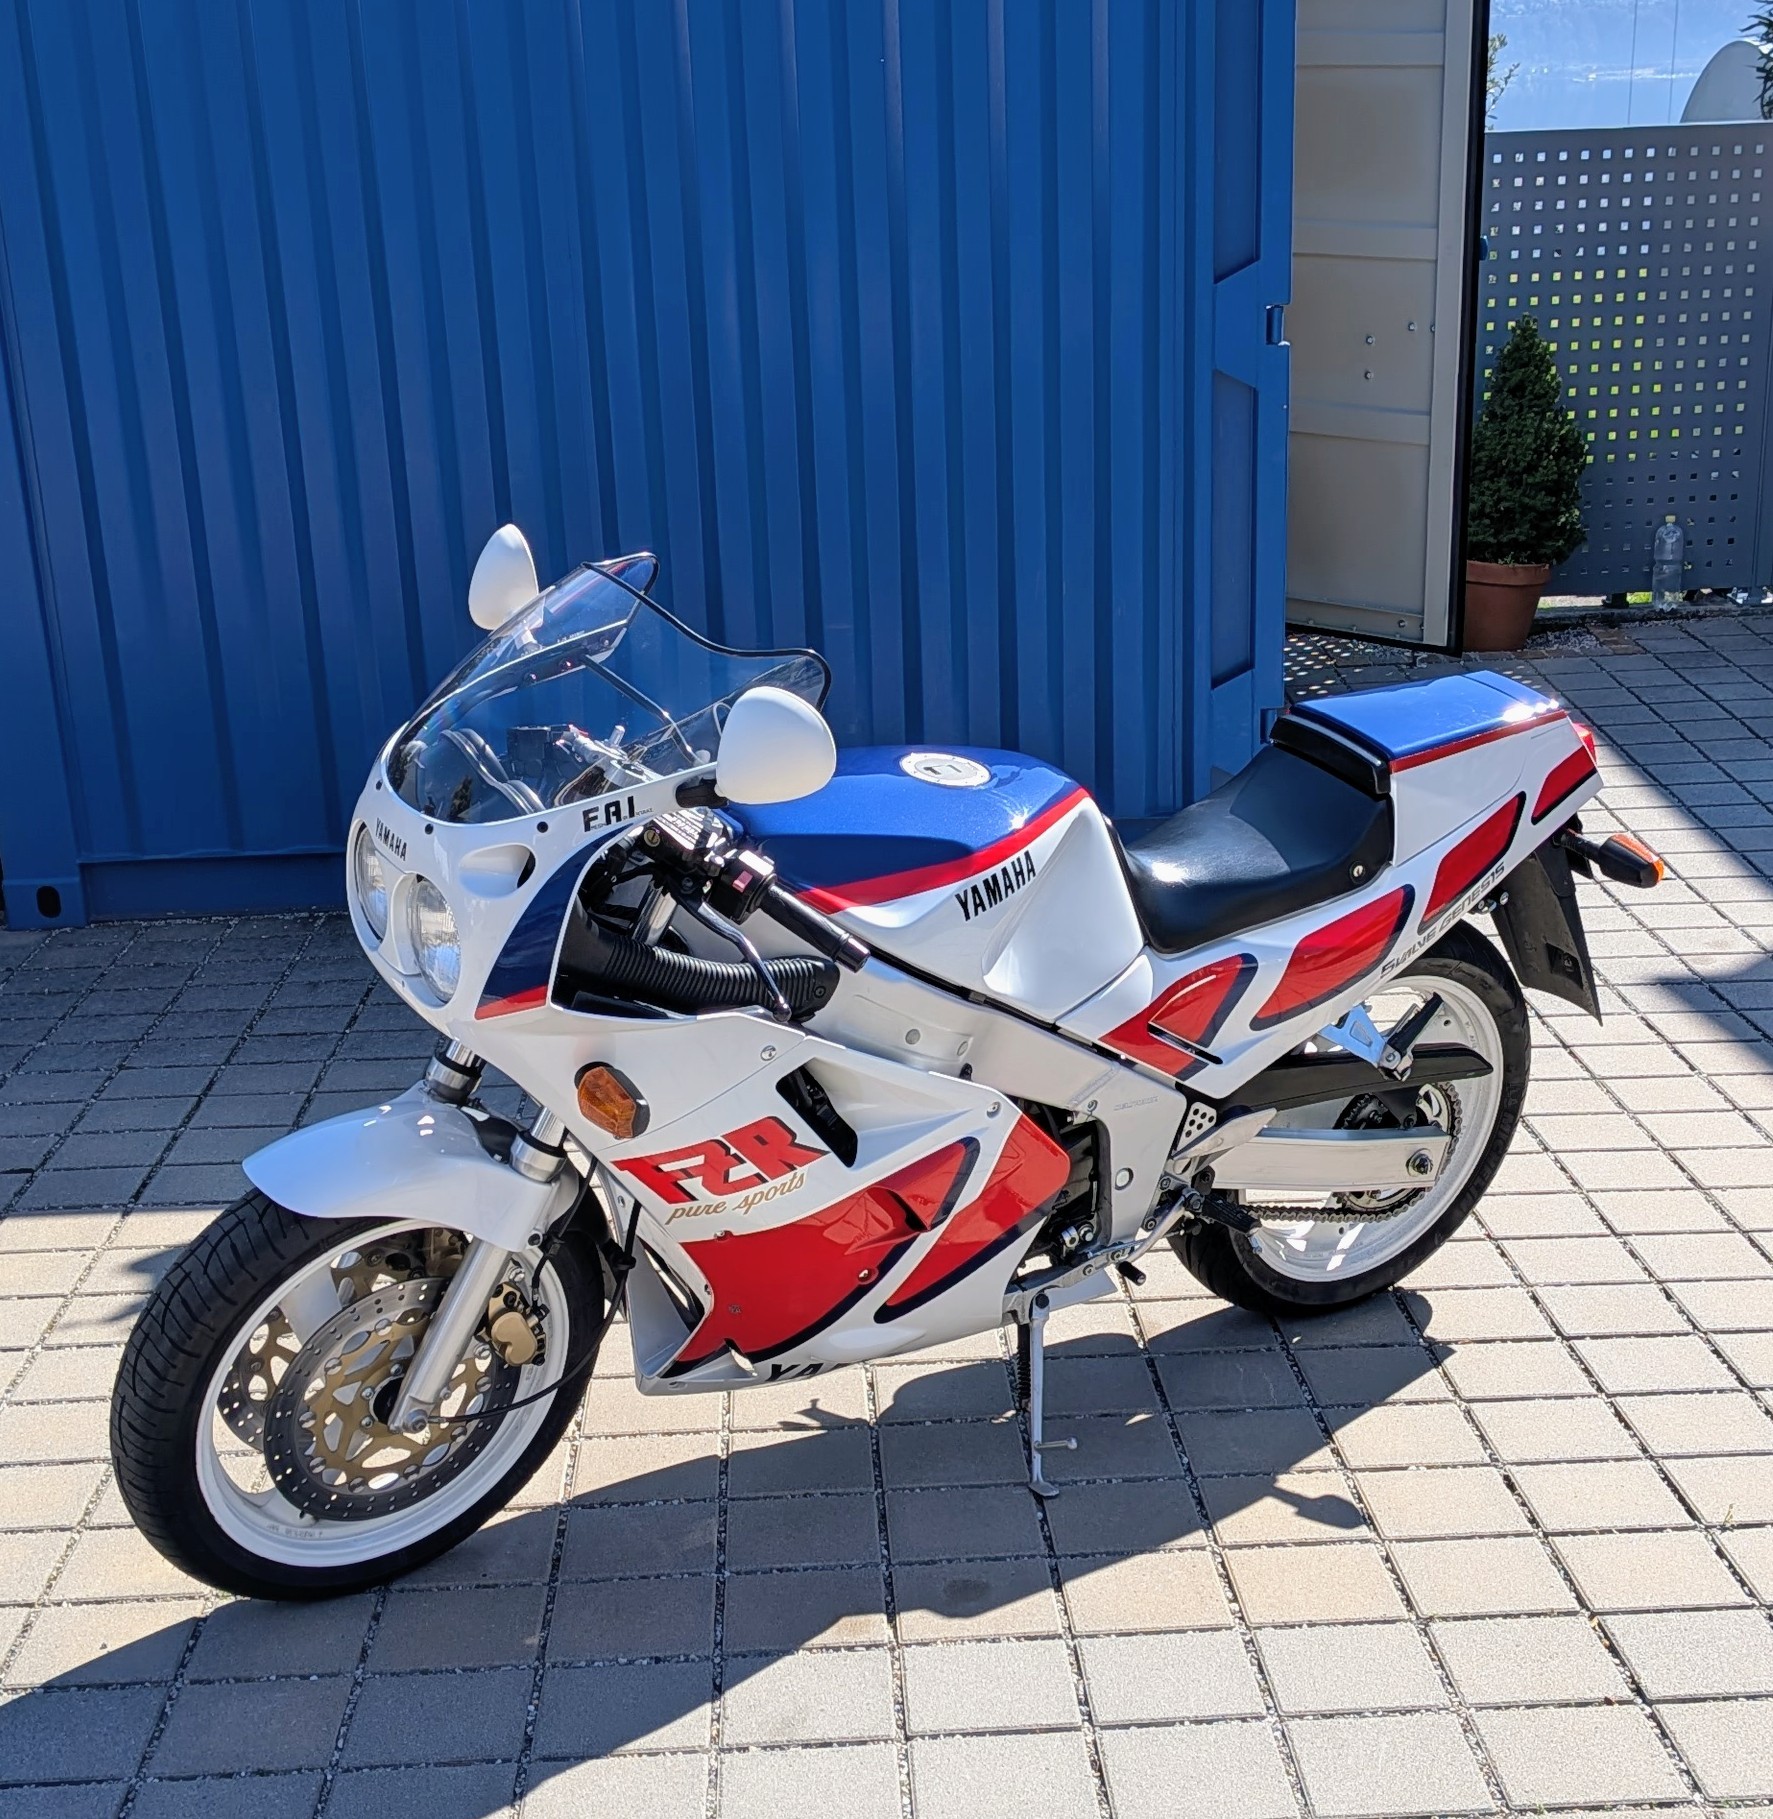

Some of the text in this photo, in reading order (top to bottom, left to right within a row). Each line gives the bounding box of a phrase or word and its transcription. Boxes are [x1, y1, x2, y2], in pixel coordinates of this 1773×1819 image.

[376, 817, 407, 861] YAMAHA
[955, 850, 1036, 921] YAMAHA
[1439, 861, 1504, 932] GENESIS
[609, 1116, 832, 1204] FZR
[665, 1171, 806, 1225] pure sports
[765, 1363, 852, 1382] YA
